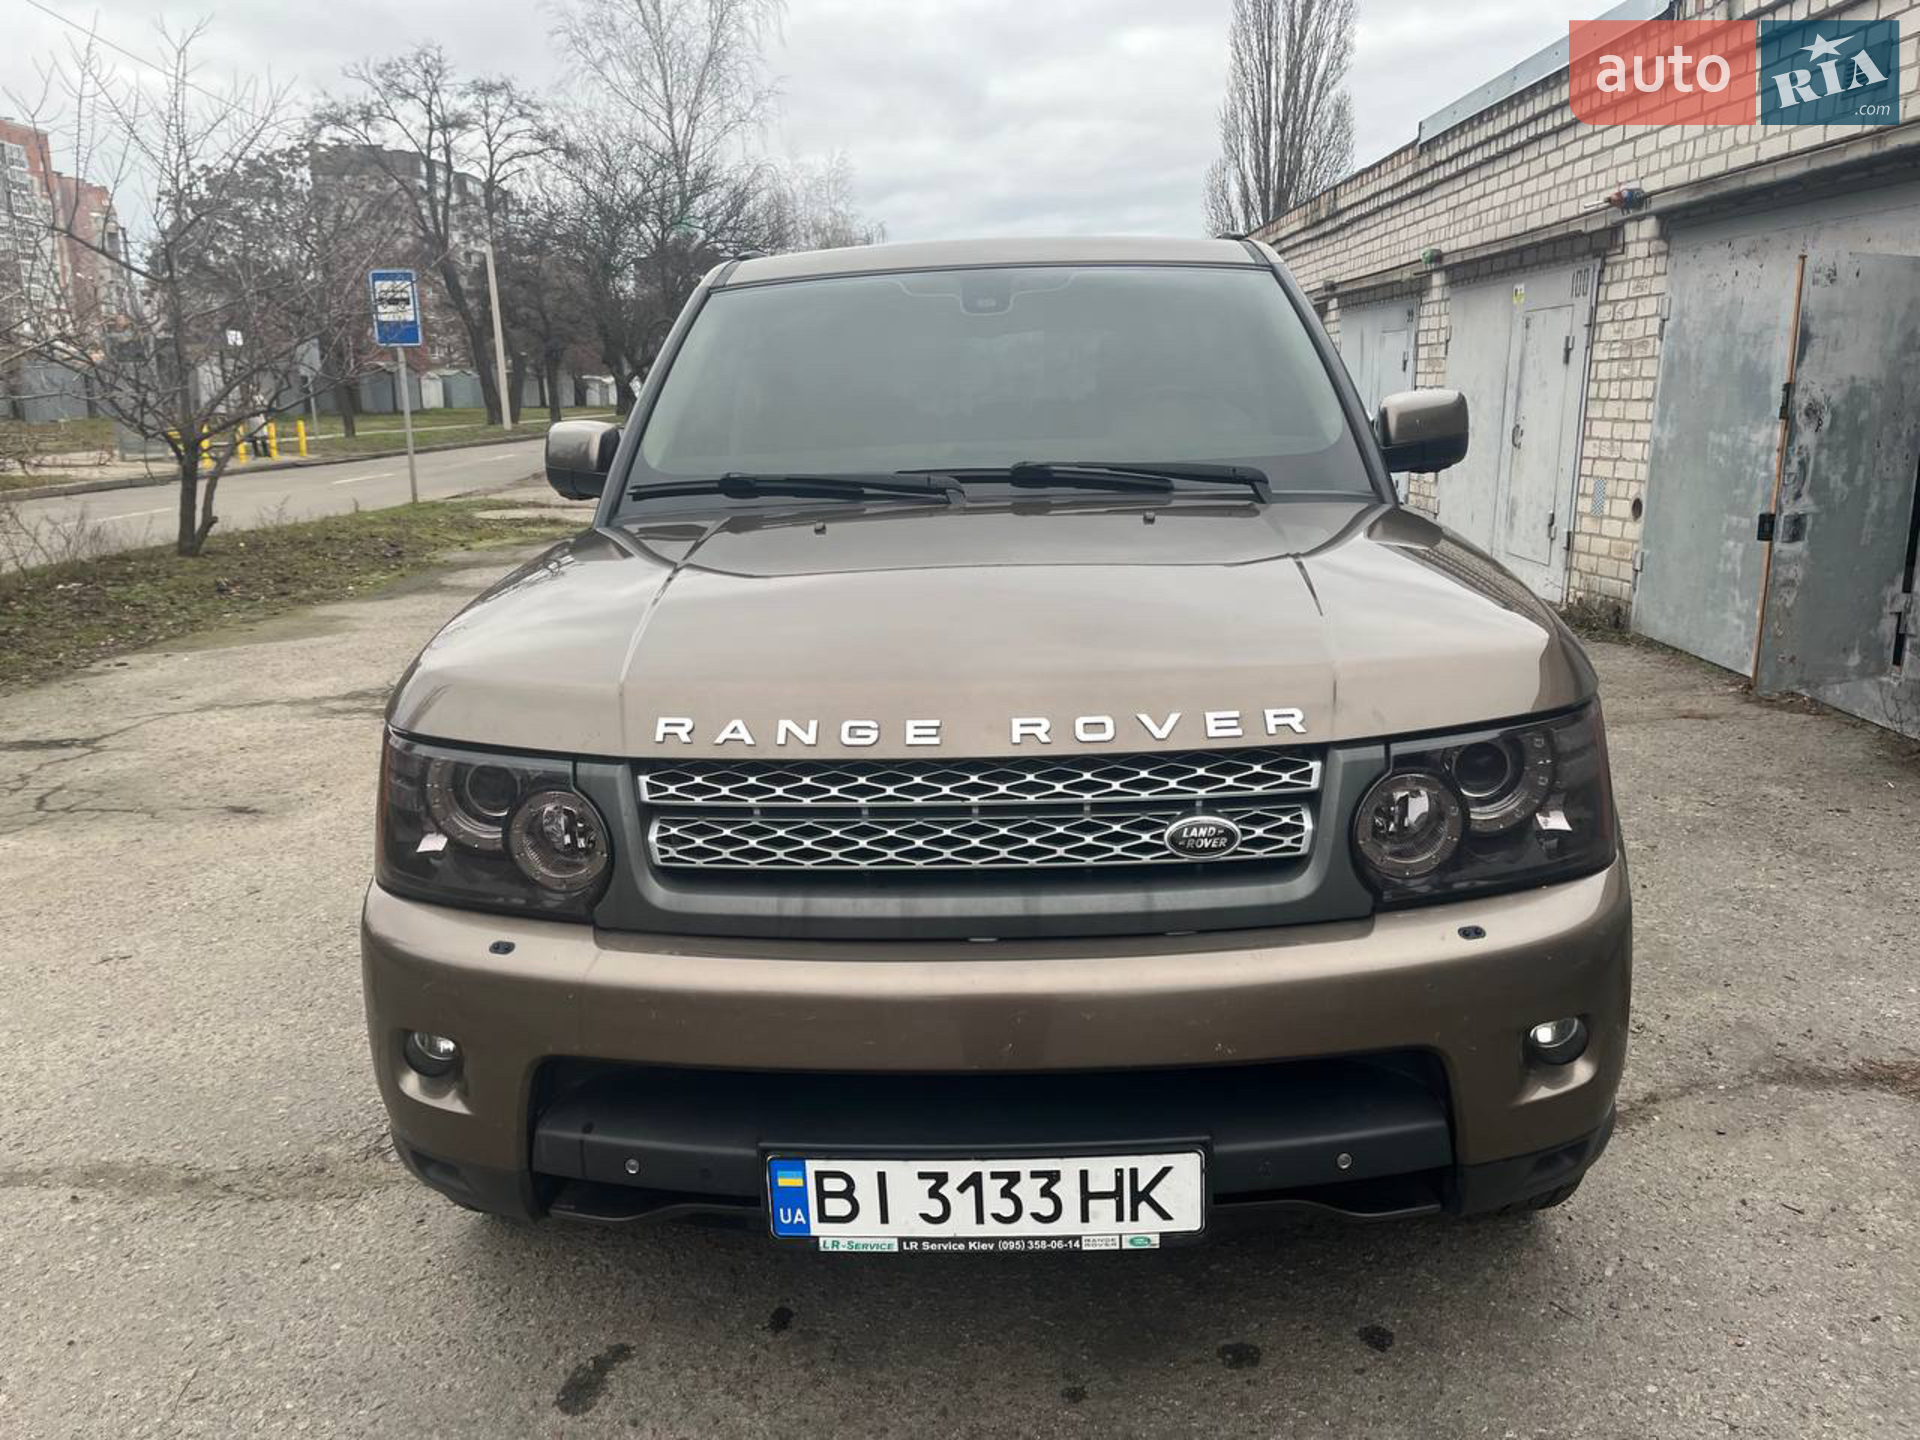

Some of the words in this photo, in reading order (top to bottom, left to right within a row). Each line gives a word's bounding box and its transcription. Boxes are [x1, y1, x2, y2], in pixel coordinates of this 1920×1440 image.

[1571, 267, 1590, 298] 100
[654, 716, 942, 747] RANGE
[1009, 707, 1308, 744] ROVER
[814, 1170, 890, 1225] BI
[917, 1169, 1064, 1226] 3133
[1079, 1166, 1175, 1223] HK
[779, 1209, 807, 1225] UA
[902, 1241, 919, 1250] LR
[921, 1240, 966, 1251] Service
[968, 1240, 995, 1250] Kiev
[998, 1239, 1026, 1251] (095)
[1027, 1239, 1081, 1250] 358-06-14
